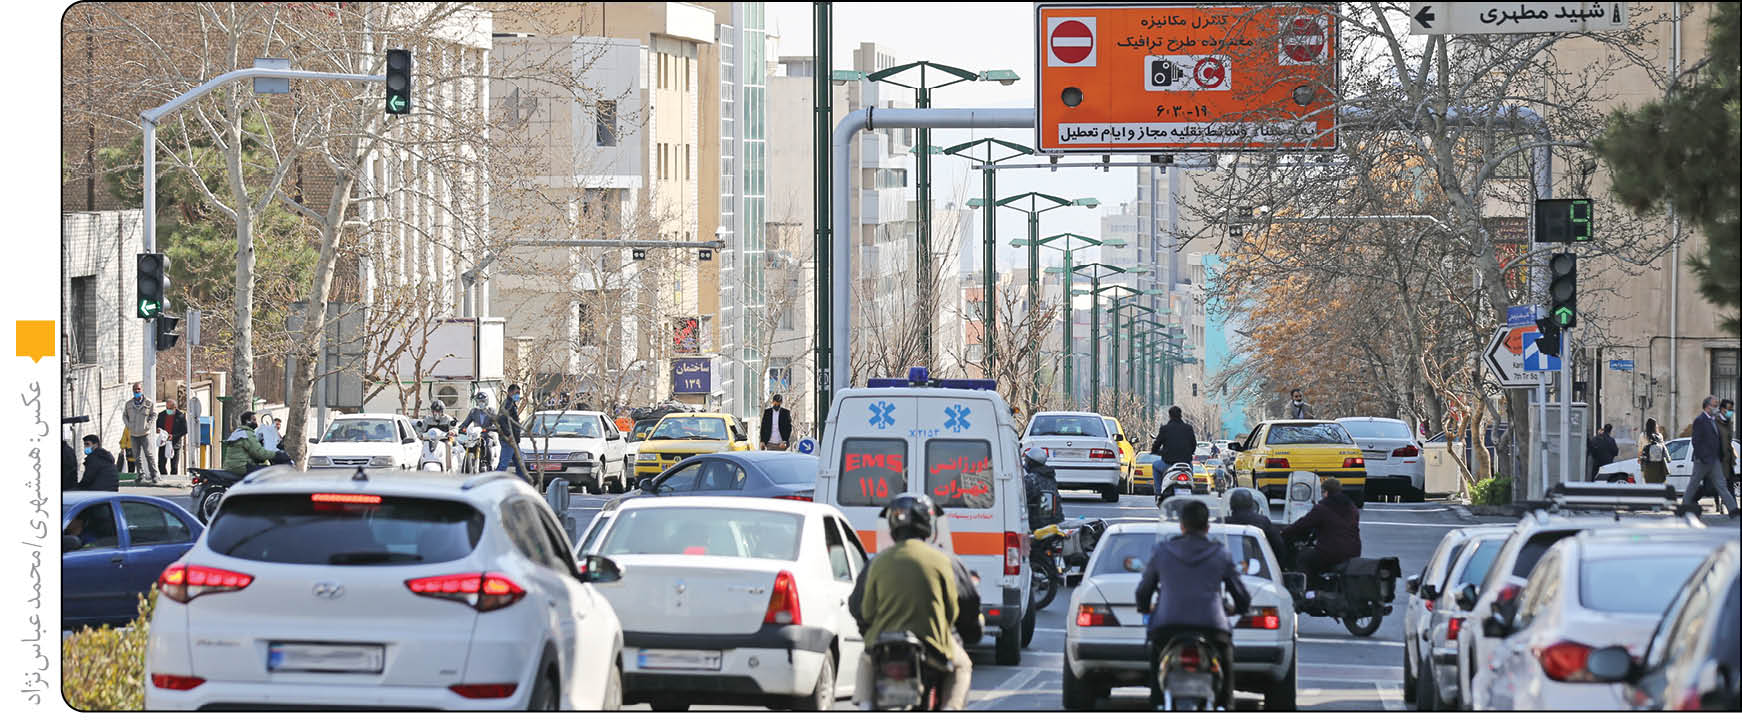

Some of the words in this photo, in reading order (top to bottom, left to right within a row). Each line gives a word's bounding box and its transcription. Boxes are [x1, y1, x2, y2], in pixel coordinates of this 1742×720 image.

[1479, 4, 1548, 25] مطهری
[1555, 1, 1604, 22] شهید
[1141, 15, 1186, 29] مکانیزه
[1192, 15, 1229, 29] کنترل
[1117, 36, 1162, 49] ترافیک
[1167, 36, 1196, 51] طرح
[1061, 127, 1098, 141] تعطیل
[1101, 127, 1126, 141] ایام
[1128, 128, 1135, 140] و
[1137, 127, 1167, 140] مجاز
[1170, 126, 1203, 139] نقلیه
[1570, 200, 1591, 240] 9
[676, 362, 709, 375] ساختمان
[845, 453, 903, 472] EMS
[930, 456, 988, 474] اورژانس
[859, 477, 888, 498] ۱۱۵
[933, 480, 988, 499] تهران
